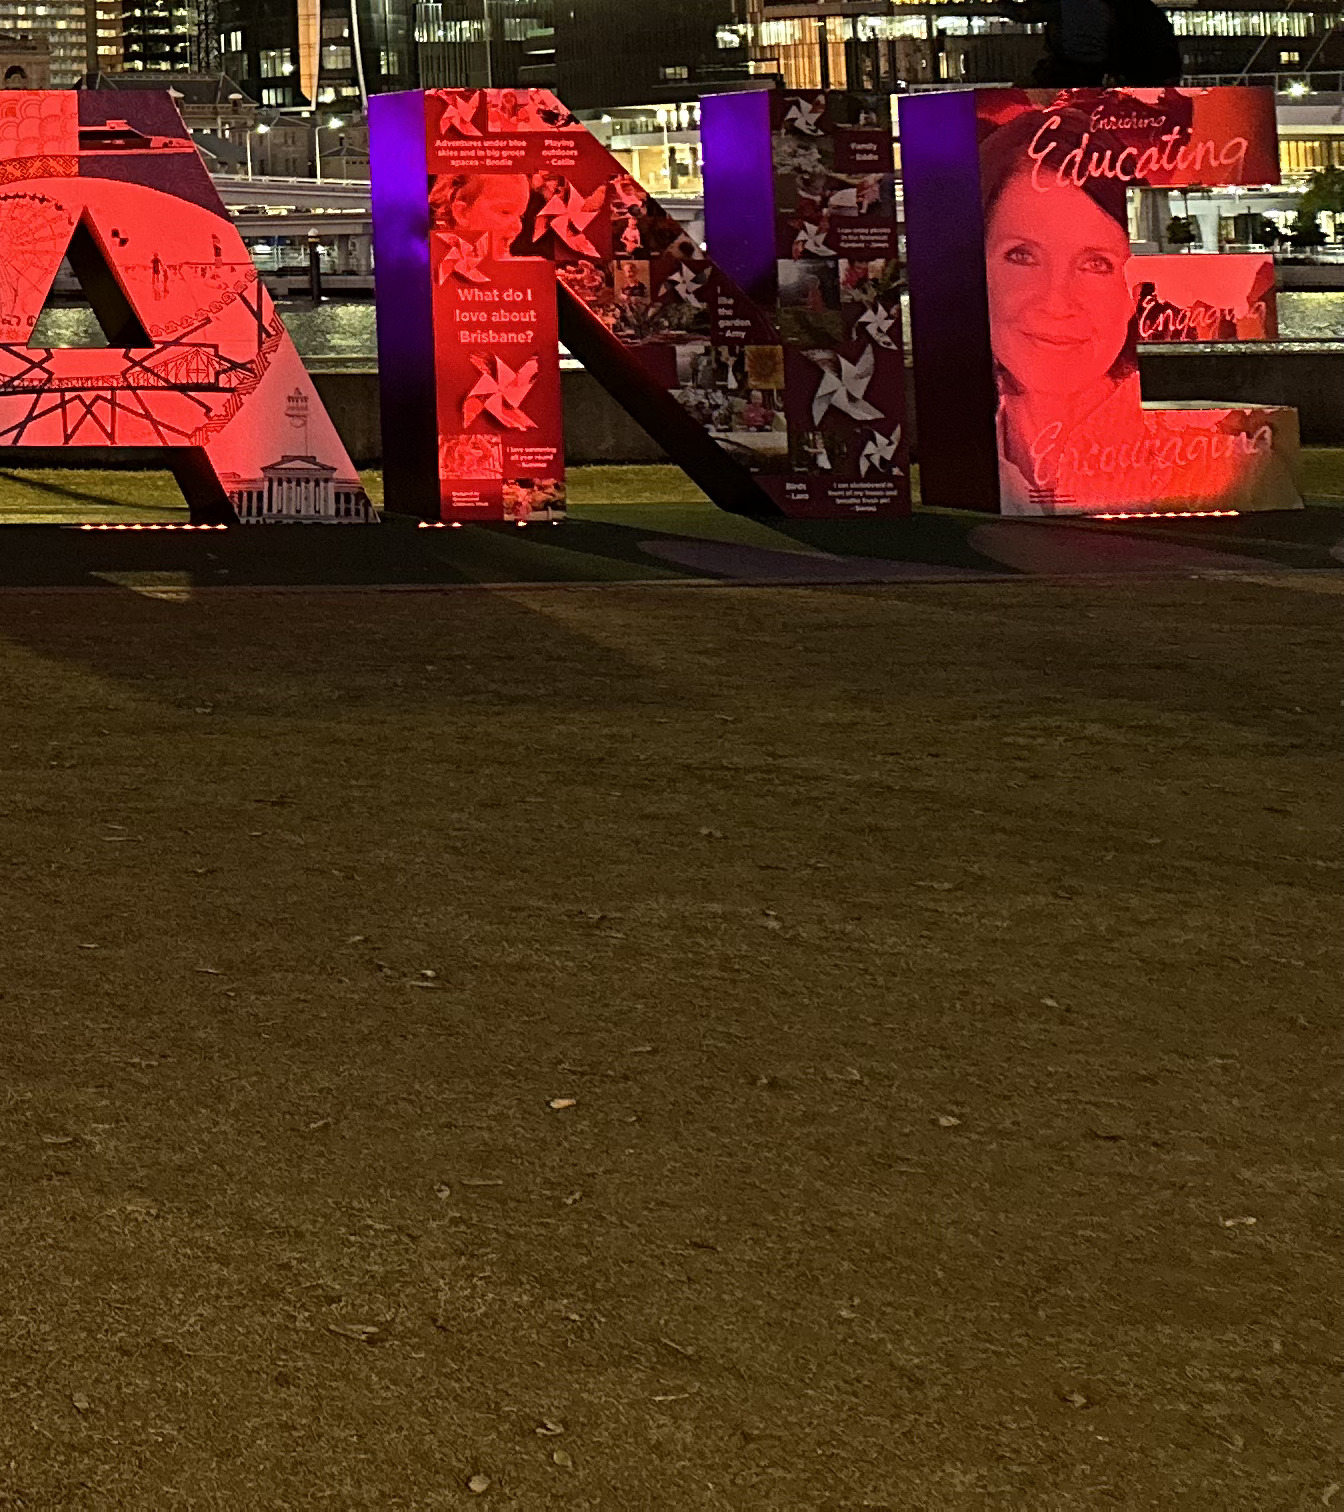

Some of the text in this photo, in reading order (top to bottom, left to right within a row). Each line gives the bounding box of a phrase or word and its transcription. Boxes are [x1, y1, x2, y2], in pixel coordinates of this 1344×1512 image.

[1089, 104, 1168, 133] Enriching
[1027, 115, 1249, 193] Educating
[457, 288, 533, 301] What do I
[455, 308, 537, 322] love about
[1138, 294, 1267, 341] Engagig
[458, 329, 534, 343] Brisbane?
